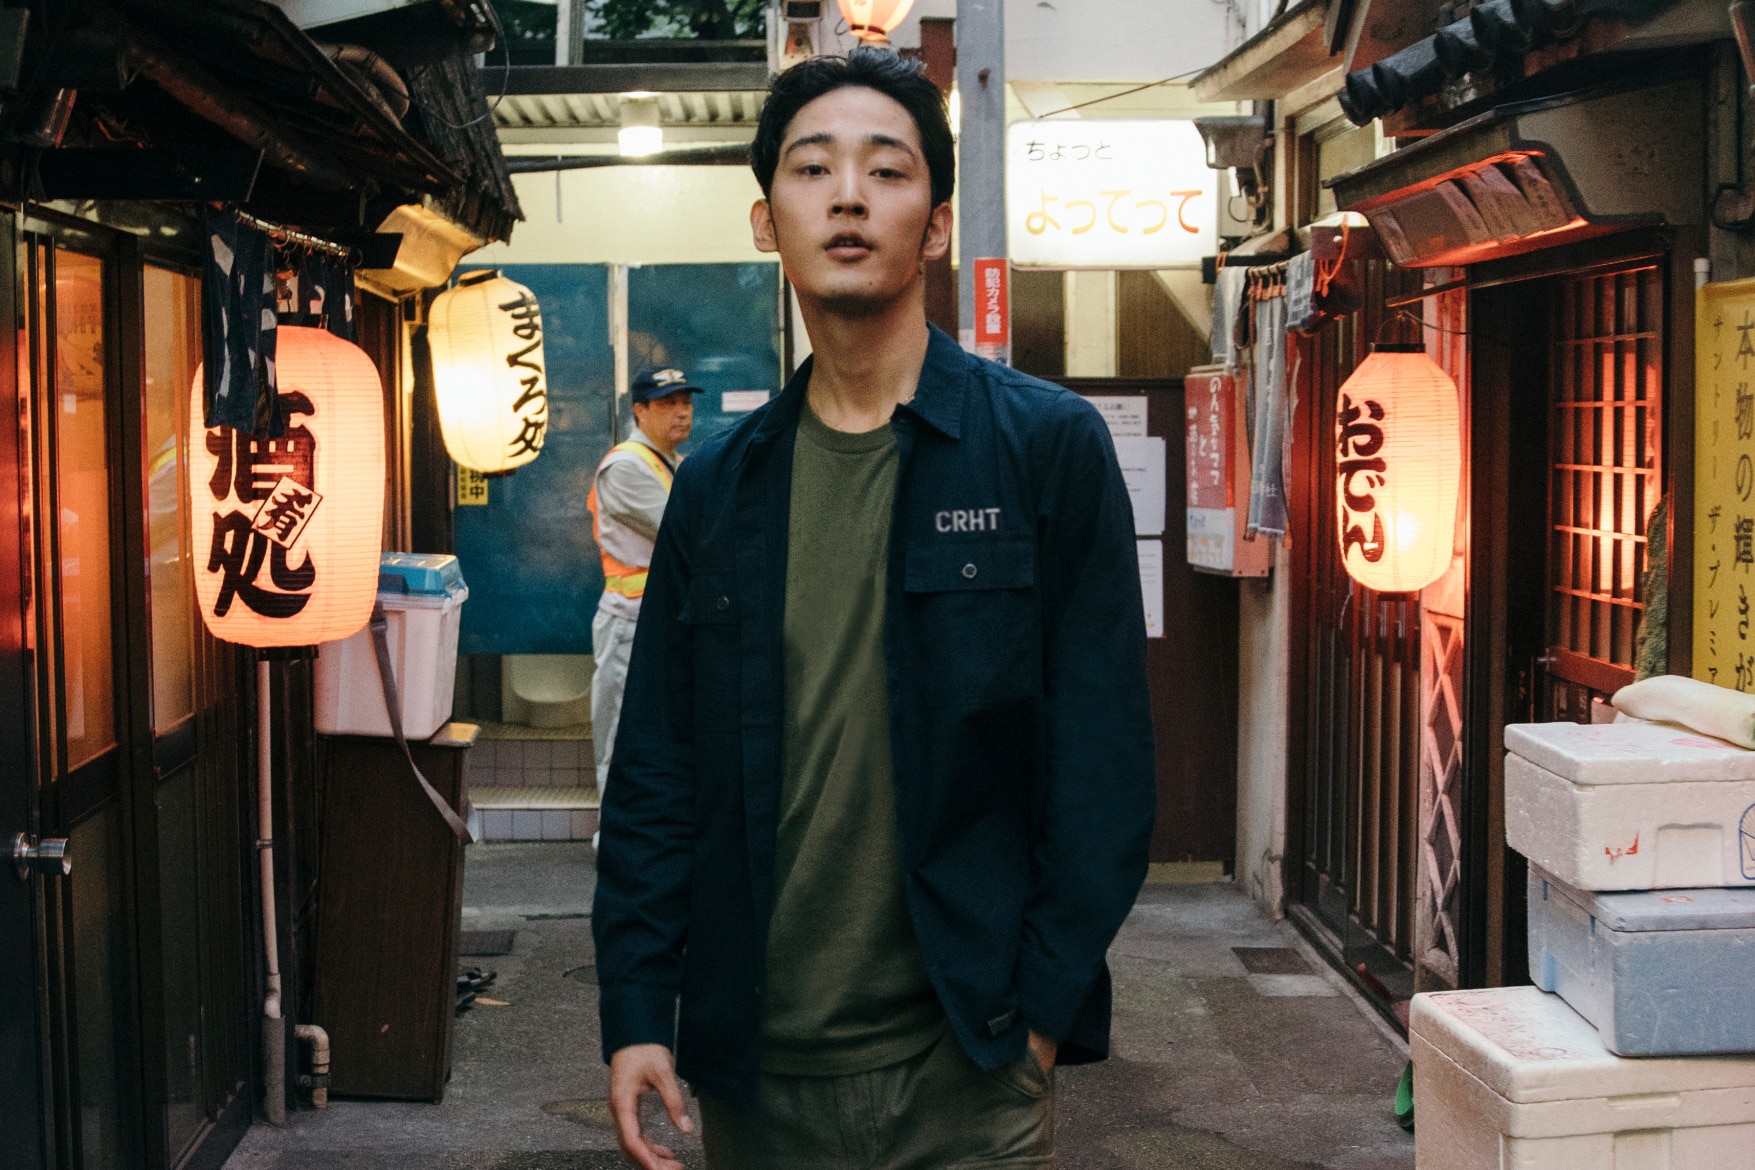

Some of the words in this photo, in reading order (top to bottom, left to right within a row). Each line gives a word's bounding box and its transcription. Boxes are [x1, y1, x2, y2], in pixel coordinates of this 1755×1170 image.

[1338, 392, 1387, 563] おでん
[257, 488, 313, 542] 肴
[935, 508, 1001, 533] CRHT
